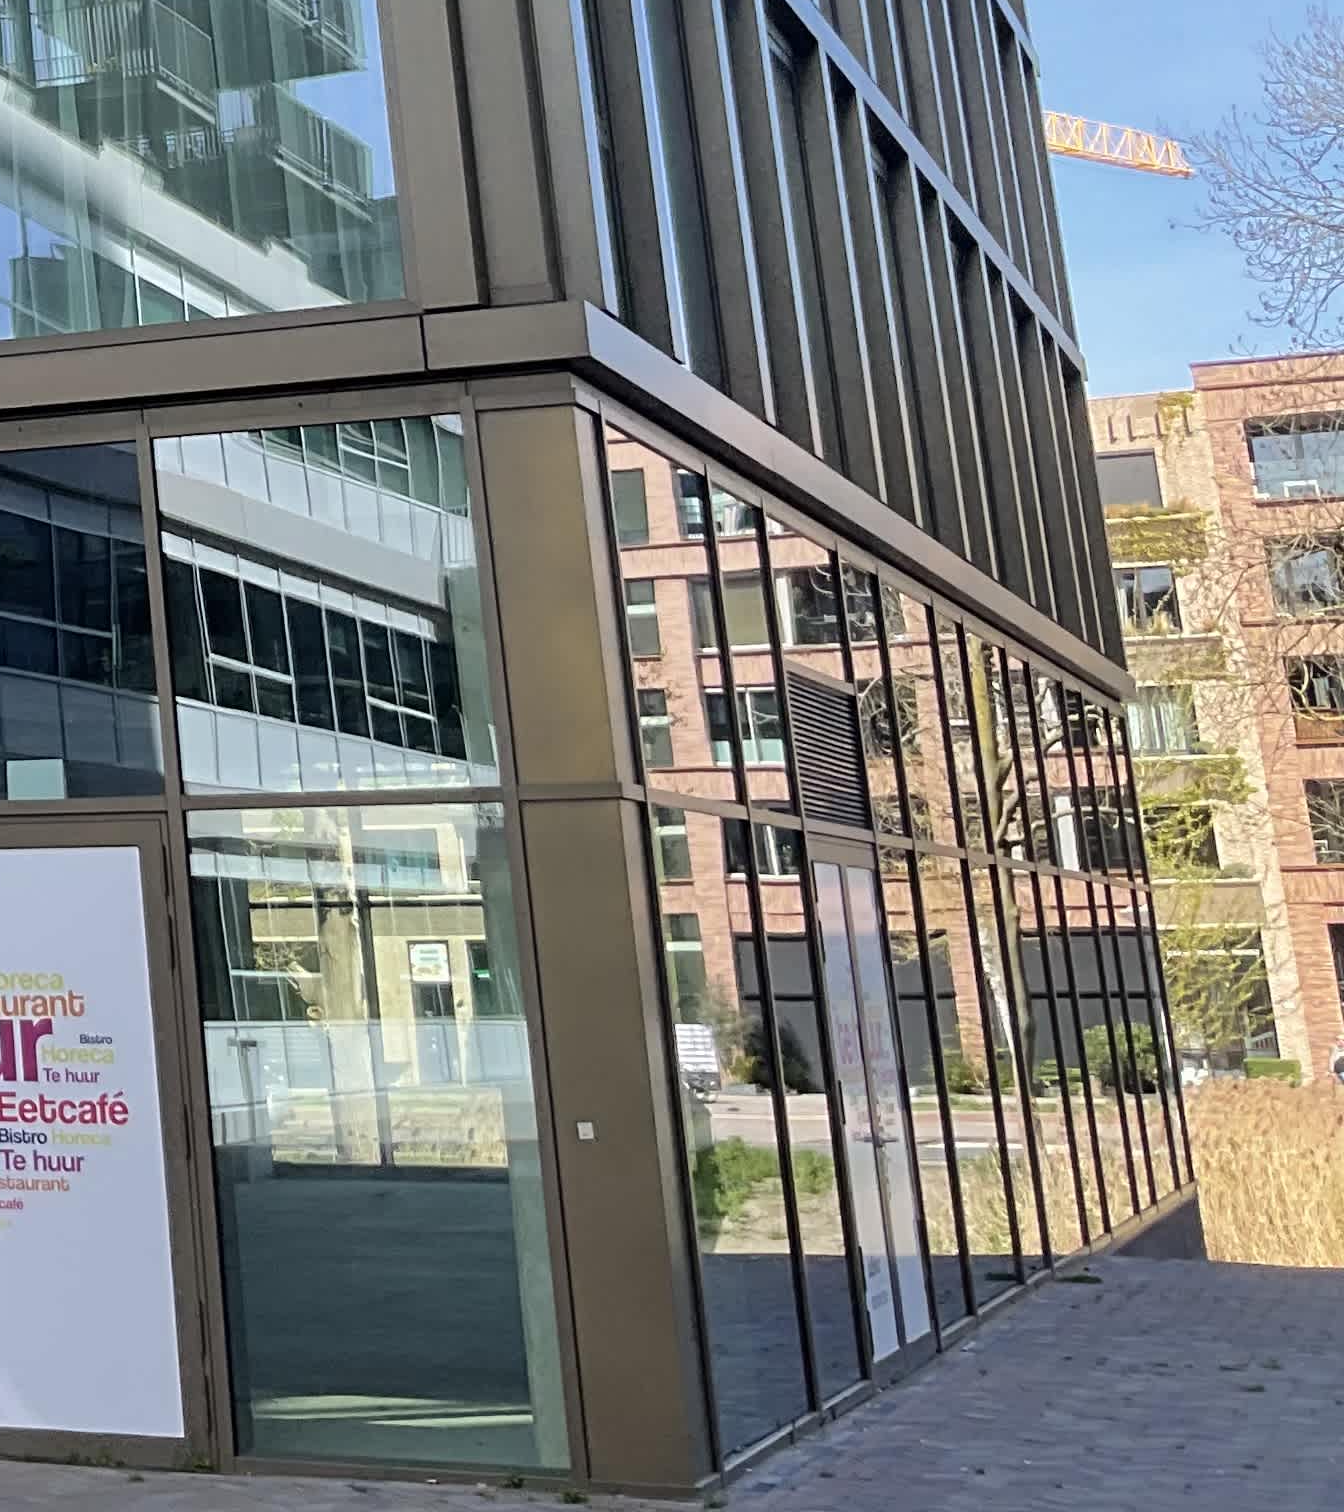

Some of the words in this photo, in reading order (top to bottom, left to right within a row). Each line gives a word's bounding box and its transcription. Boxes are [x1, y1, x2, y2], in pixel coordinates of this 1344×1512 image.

[79, 1033, 112, 1045] Bistro
[42, 1044, 114, 1064] Horeca
[43, 1067, 61, 1082] Te
[64, 1068, 100, 1084] huur
[0, 1149, 27, 1171] Te
[33, 1150, 85, 1172] huur
